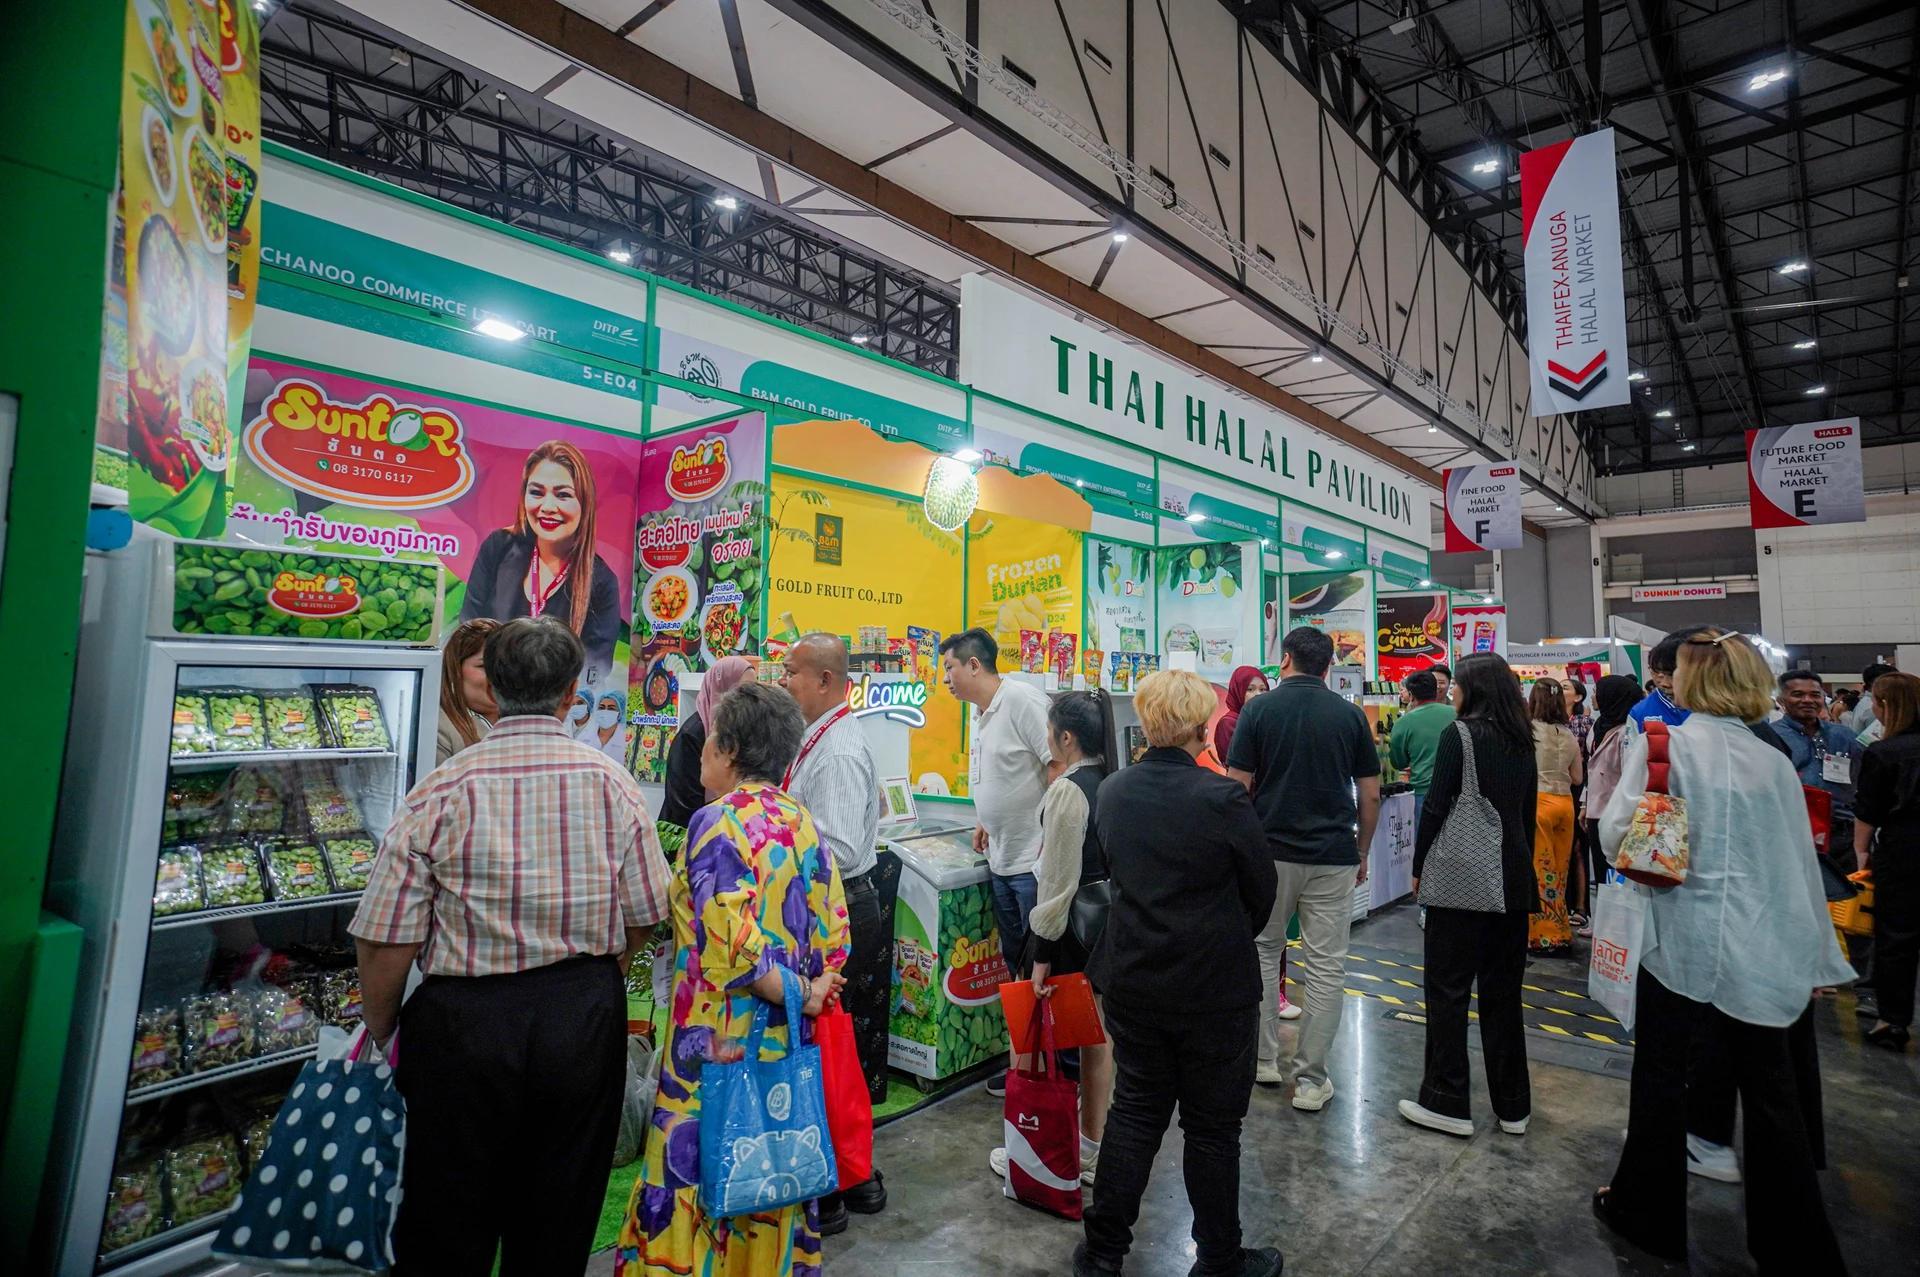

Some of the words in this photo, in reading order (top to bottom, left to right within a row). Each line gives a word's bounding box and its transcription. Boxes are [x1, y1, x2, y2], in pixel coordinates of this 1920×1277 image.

[1574, 214, 1594, 283] MARKET
[260, 246, 356, 284] CHANOO
[362, 276, 468, 316] COMMERCE
[1550, 210, 1573, 350] THAIFEX-ANUGA
[1578, 288, 1598, 344] HALAL
[593, 320, 620, 335] DITP
[582, 366, 637, 392] 5-E04
[752, 387, 780, 404] B&M
[1050, 335, 1164, 430] THAI
[1186, 394, 1295, 480] HALAL
[1308, 449, 1411, 526] PAVILION
[1819, 428, 1840, 437] HALL
[1760, 445, 1805, 457] FUTURE
[1808, 440, 1846, 452] FOOD
[1778, 452, 1826, 465] MARKET
[333, 463, 348, 474] 08
[352, 466, 382, 480] 3170
[385, 471, 414, 485] 6117
[1784, 466, 1823, 478] HALAL
[1461, 487, 1478, 496] FINE
[1480, 484, 1506, 494] FOOD
[1780, 476, 1828, 488] MARKET
[1467, 504, 1500, 514] MARKET
[1470, 497, 1496, 506] HALAL
[1794, 488, 1818, 518] E
[1476, 520, 1490, 544] F
[1764, 545, 1772, 555] 5
[986, 554, 1061, 584] Frozen
[1593, 557, 1599, 566] 6
[776, 578, 812, 594] GOLD
[816, 583, 854, 600] FRUIT
[992, 574, 1062, 602] Durian
[1643, 589, 1683, 598] DUNKIN'
[1683, 588, 1722, 596] DONUTS
[1048, 613, 1066, 624] D24
[1377, 628, 1426, 653] Curve
